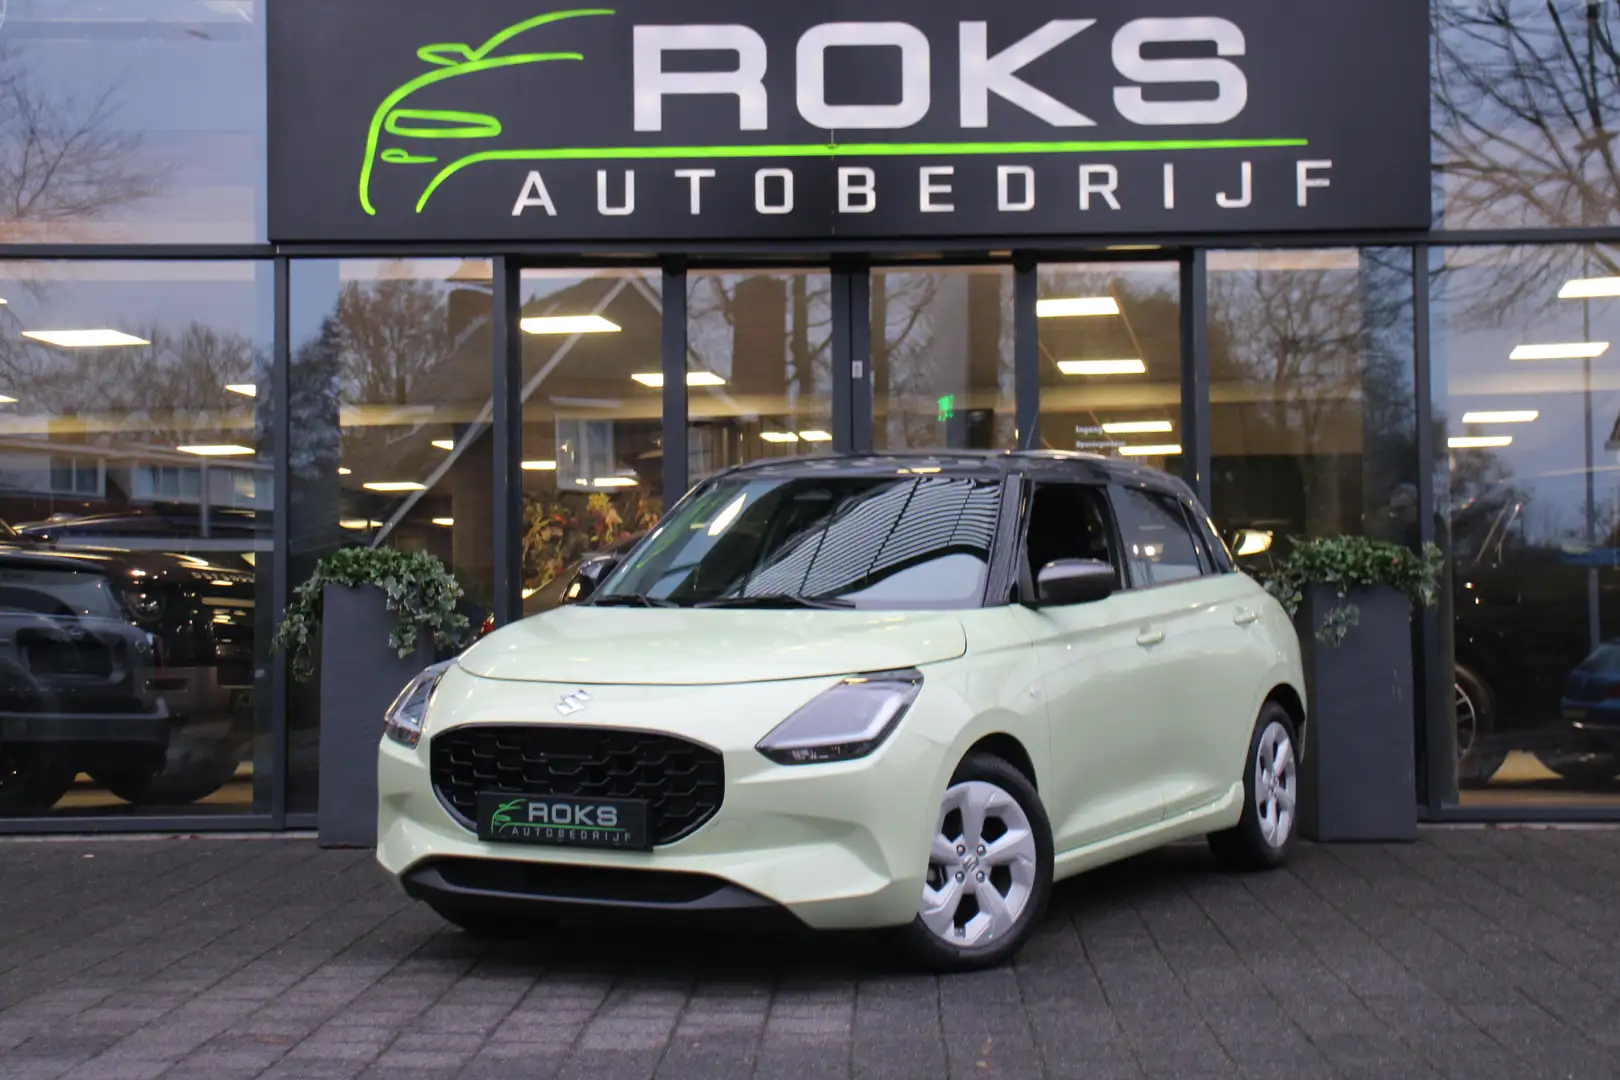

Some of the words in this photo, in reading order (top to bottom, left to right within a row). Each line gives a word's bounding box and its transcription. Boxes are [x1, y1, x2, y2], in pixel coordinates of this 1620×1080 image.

[633, 17, 1248, 132] ROKS
[511, 160, 1332, 217] AUTOBEDRIJF
[511, 826, 631, 842] AUTOBEDRIJF
[528, 802, 618, 827] ROKS
